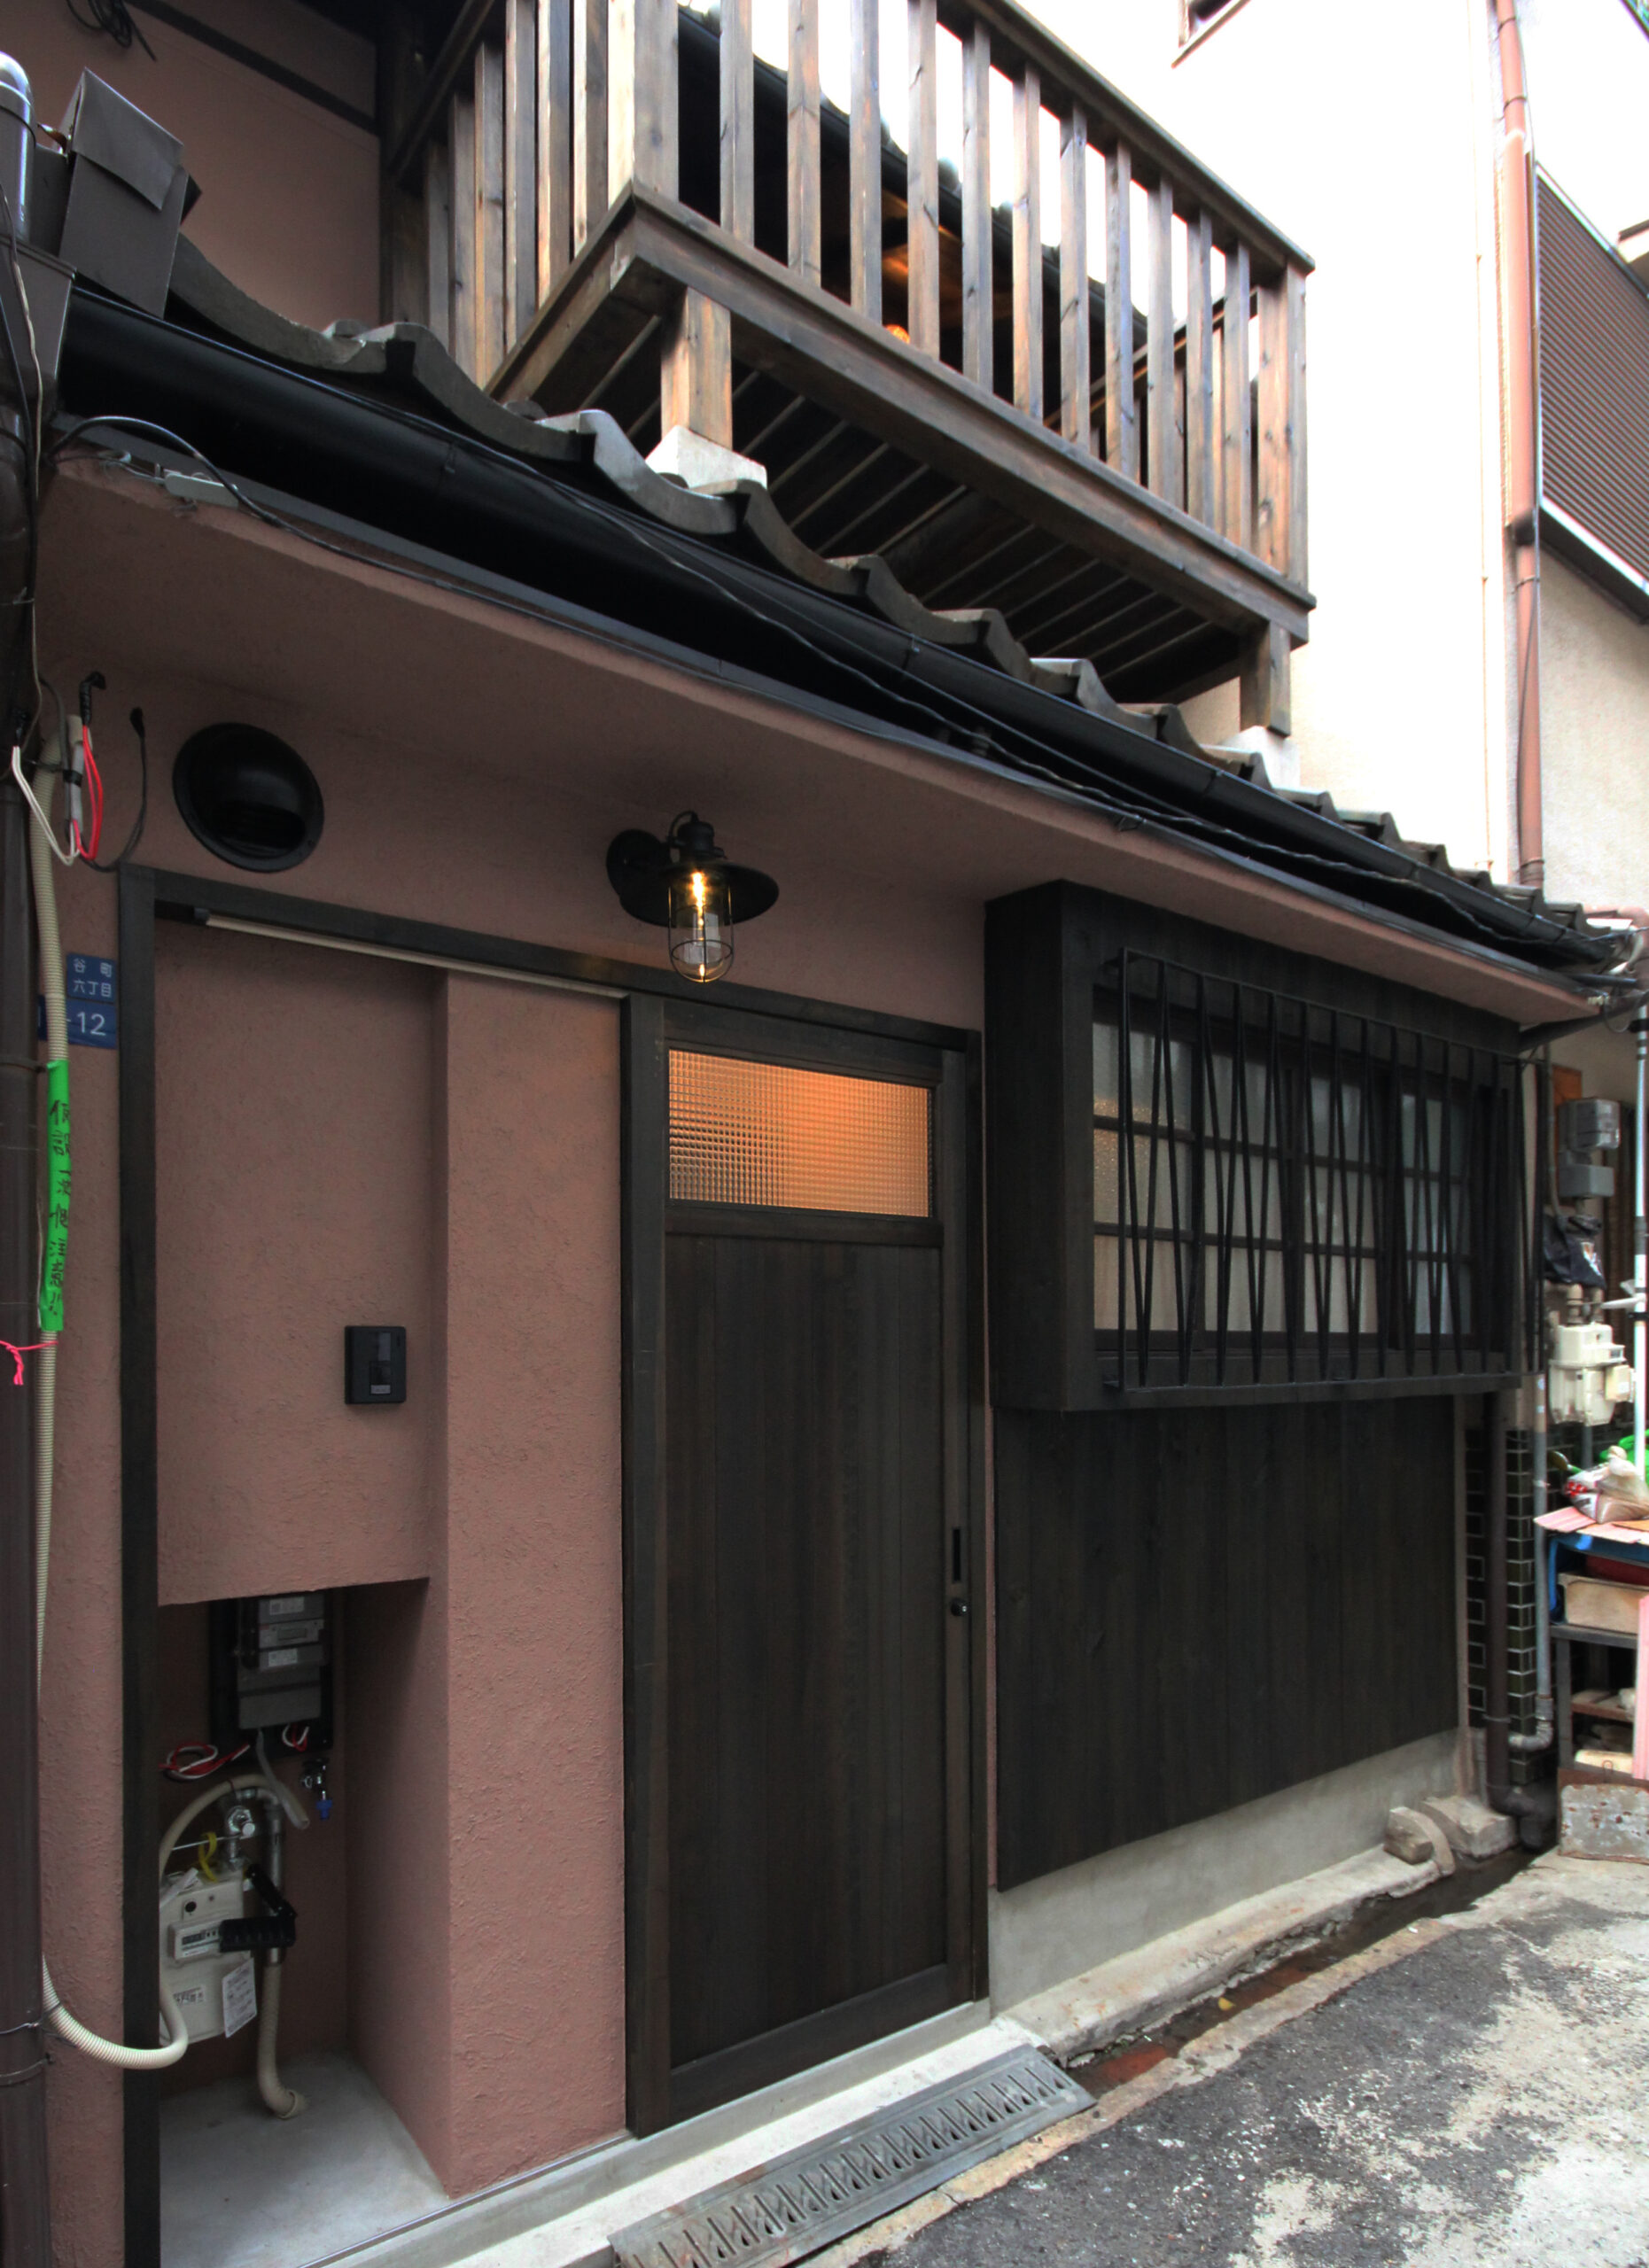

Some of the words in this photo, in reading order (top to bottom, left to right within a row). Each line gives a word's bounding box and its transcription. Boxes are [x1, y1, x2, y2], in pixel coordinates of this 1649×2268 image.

[73, 958, 113, 977] 谷町
[74, 979, 112, 998] 六丁目
